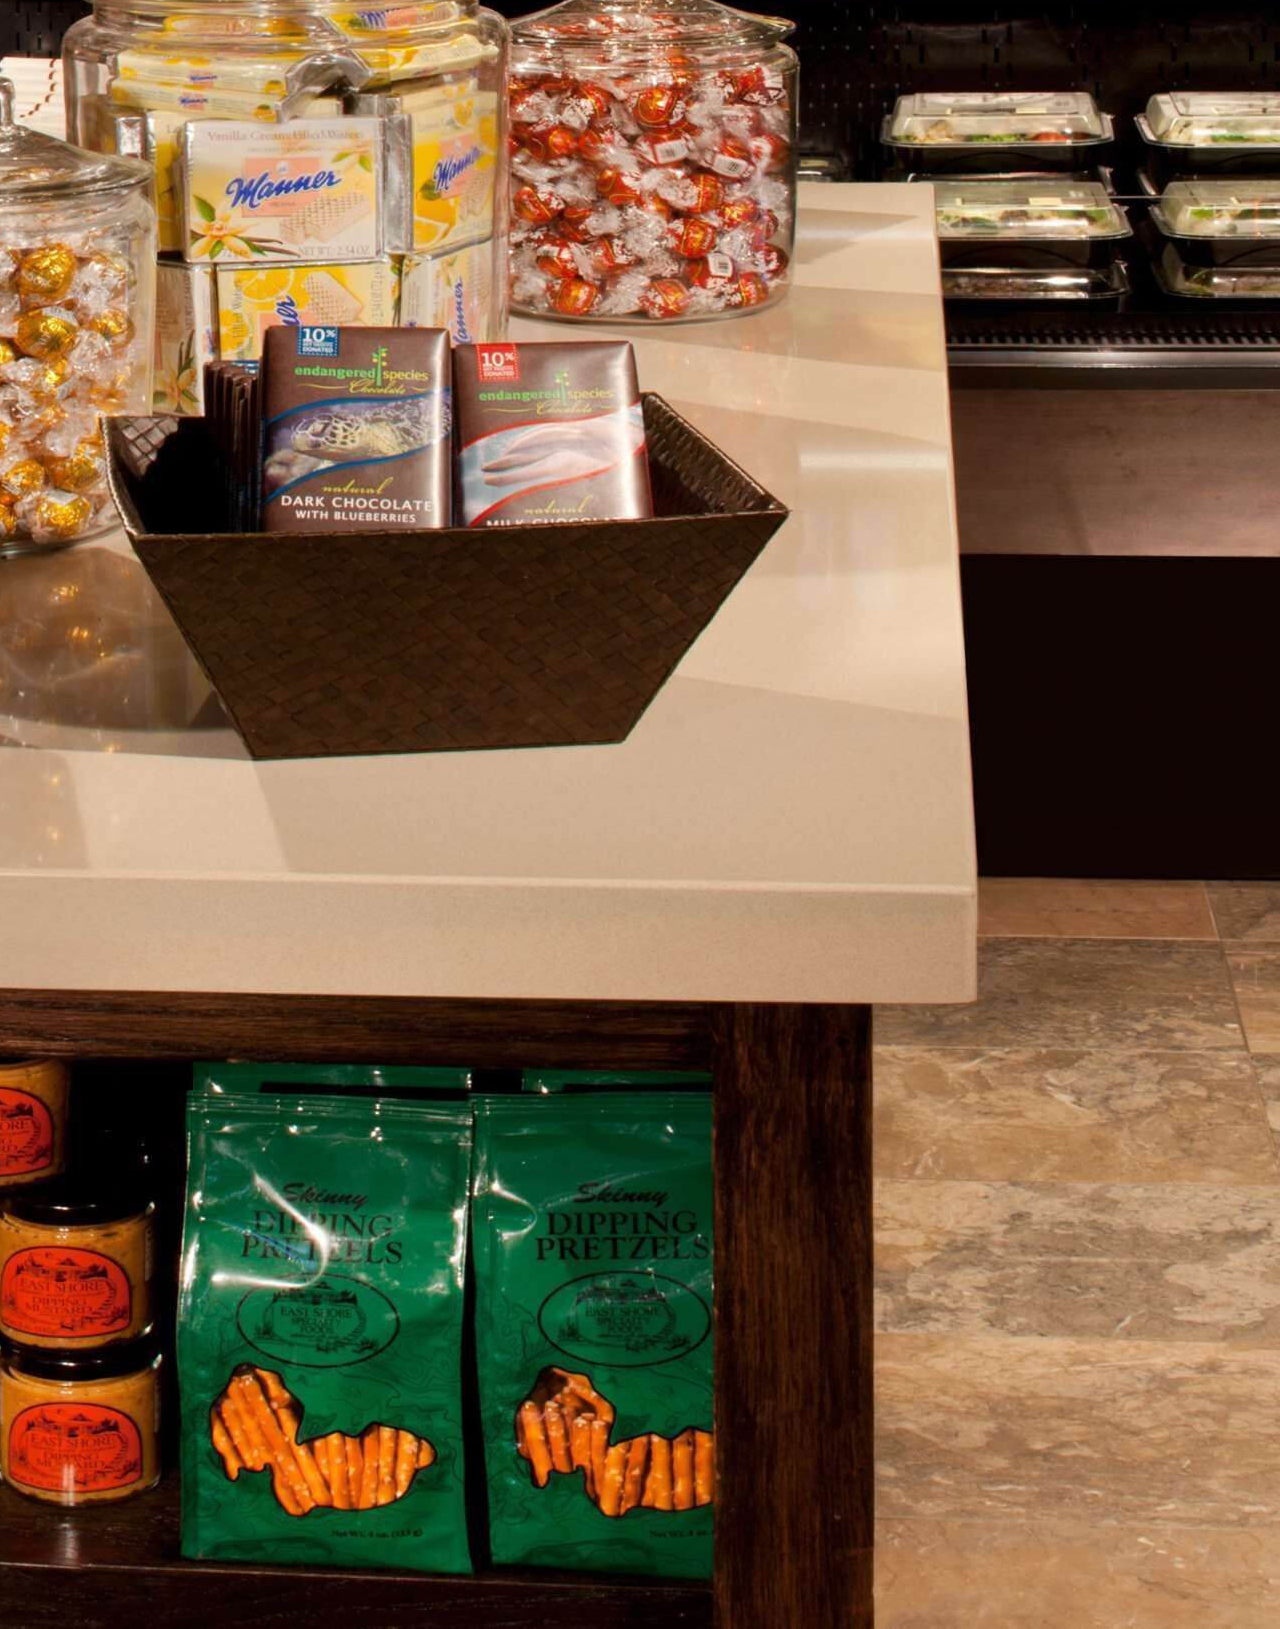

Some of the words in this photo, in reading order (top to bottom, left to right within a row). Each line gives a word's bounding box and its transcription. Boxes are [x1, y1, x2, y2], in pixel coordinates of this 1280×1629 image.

[206, 129, 248, 142] Vanilla
[432, 145, 483, 192] Manner
[225, 169, 345, 211] Manner
[301, 328, 337, 344] 10%
[301, 346, 335, 354] DONATED
[480, 351, 516, 368] 10%
[294, 365, 377, 380] endangered
[382, 370, 430, 382] species
[348, 379, 407, 396] Chocolate
[478, 389, 562, 403] endangered
[566, 388, 614, 401] species
[322, 477, 395, 496] natural
[280, 495, 326, 508] DARK
[331, 496, 434, 513] CHOCOLATE
[294, 509, 330, 521] WITH
[333, 510, 417, 524] BLUEBERRIES
[281, 1182, 370, 1211] Skinny
[572, 1182, 669, 1210] Skinny
[546, 1209, 699, 1236] DIPPING
[534, 1234, 710, 1262] PRETZELS
[19, 1277, 52, 1292] EAST
[55, 1281, 105, 1293] SHORE
[24, 1303, 95, 1315] MUSTARD
[31, 1296, 88, 1306] DIPPING
[280, 1306, 311, 1318] EAST
[313, 1307, 353, 1318] SHORE
[584, 1305, 614, 1317] EAST
